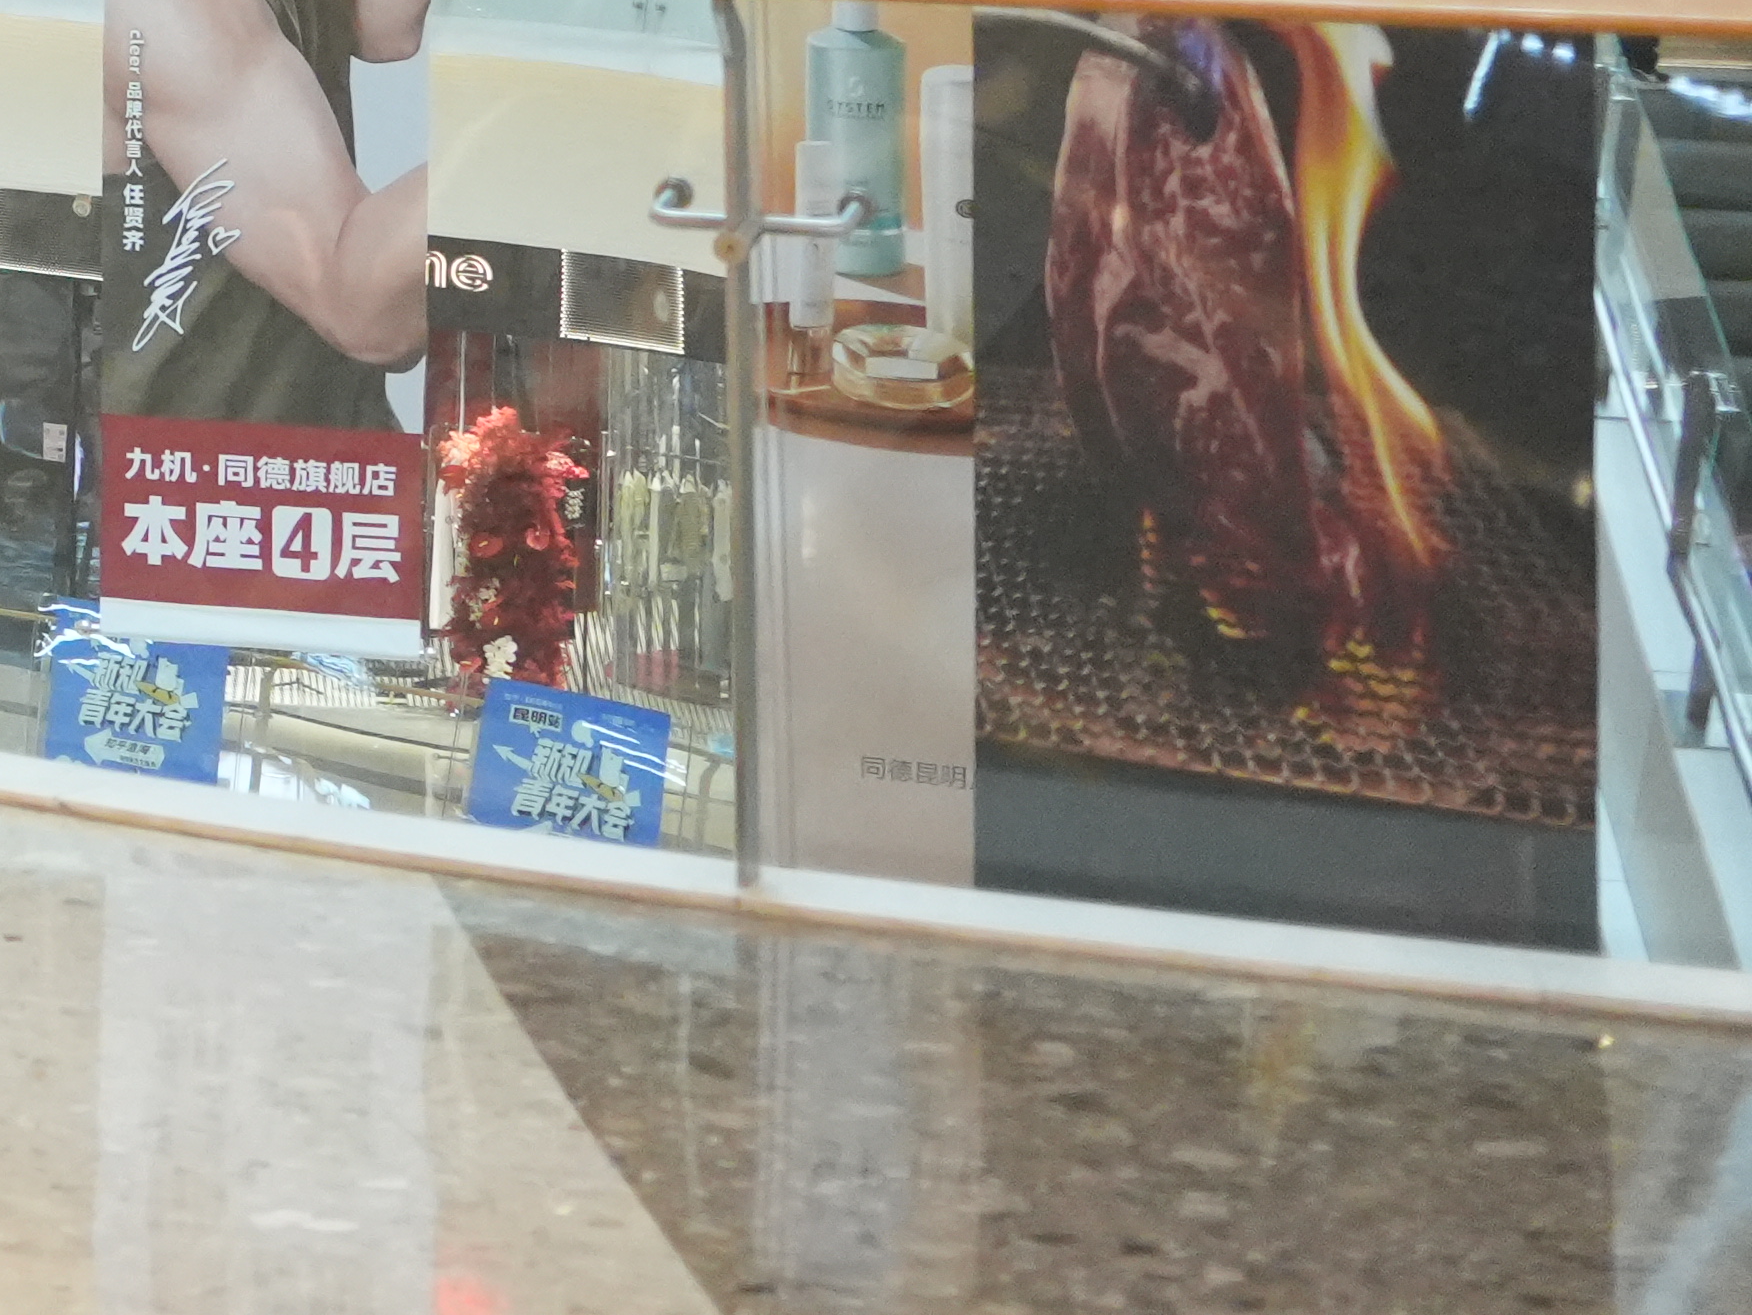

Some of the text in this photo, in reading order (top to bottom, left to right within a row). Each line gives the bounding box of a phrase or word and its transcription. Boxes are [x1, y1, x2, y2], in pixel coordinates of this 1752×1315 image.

[124, 81, 143, 177] 品牌代言人
[122, 183, 145, 253] 任贤齐
[121, 495, 402, 584] 本座4层
[861, 756, 974, 791] 同德昆明
